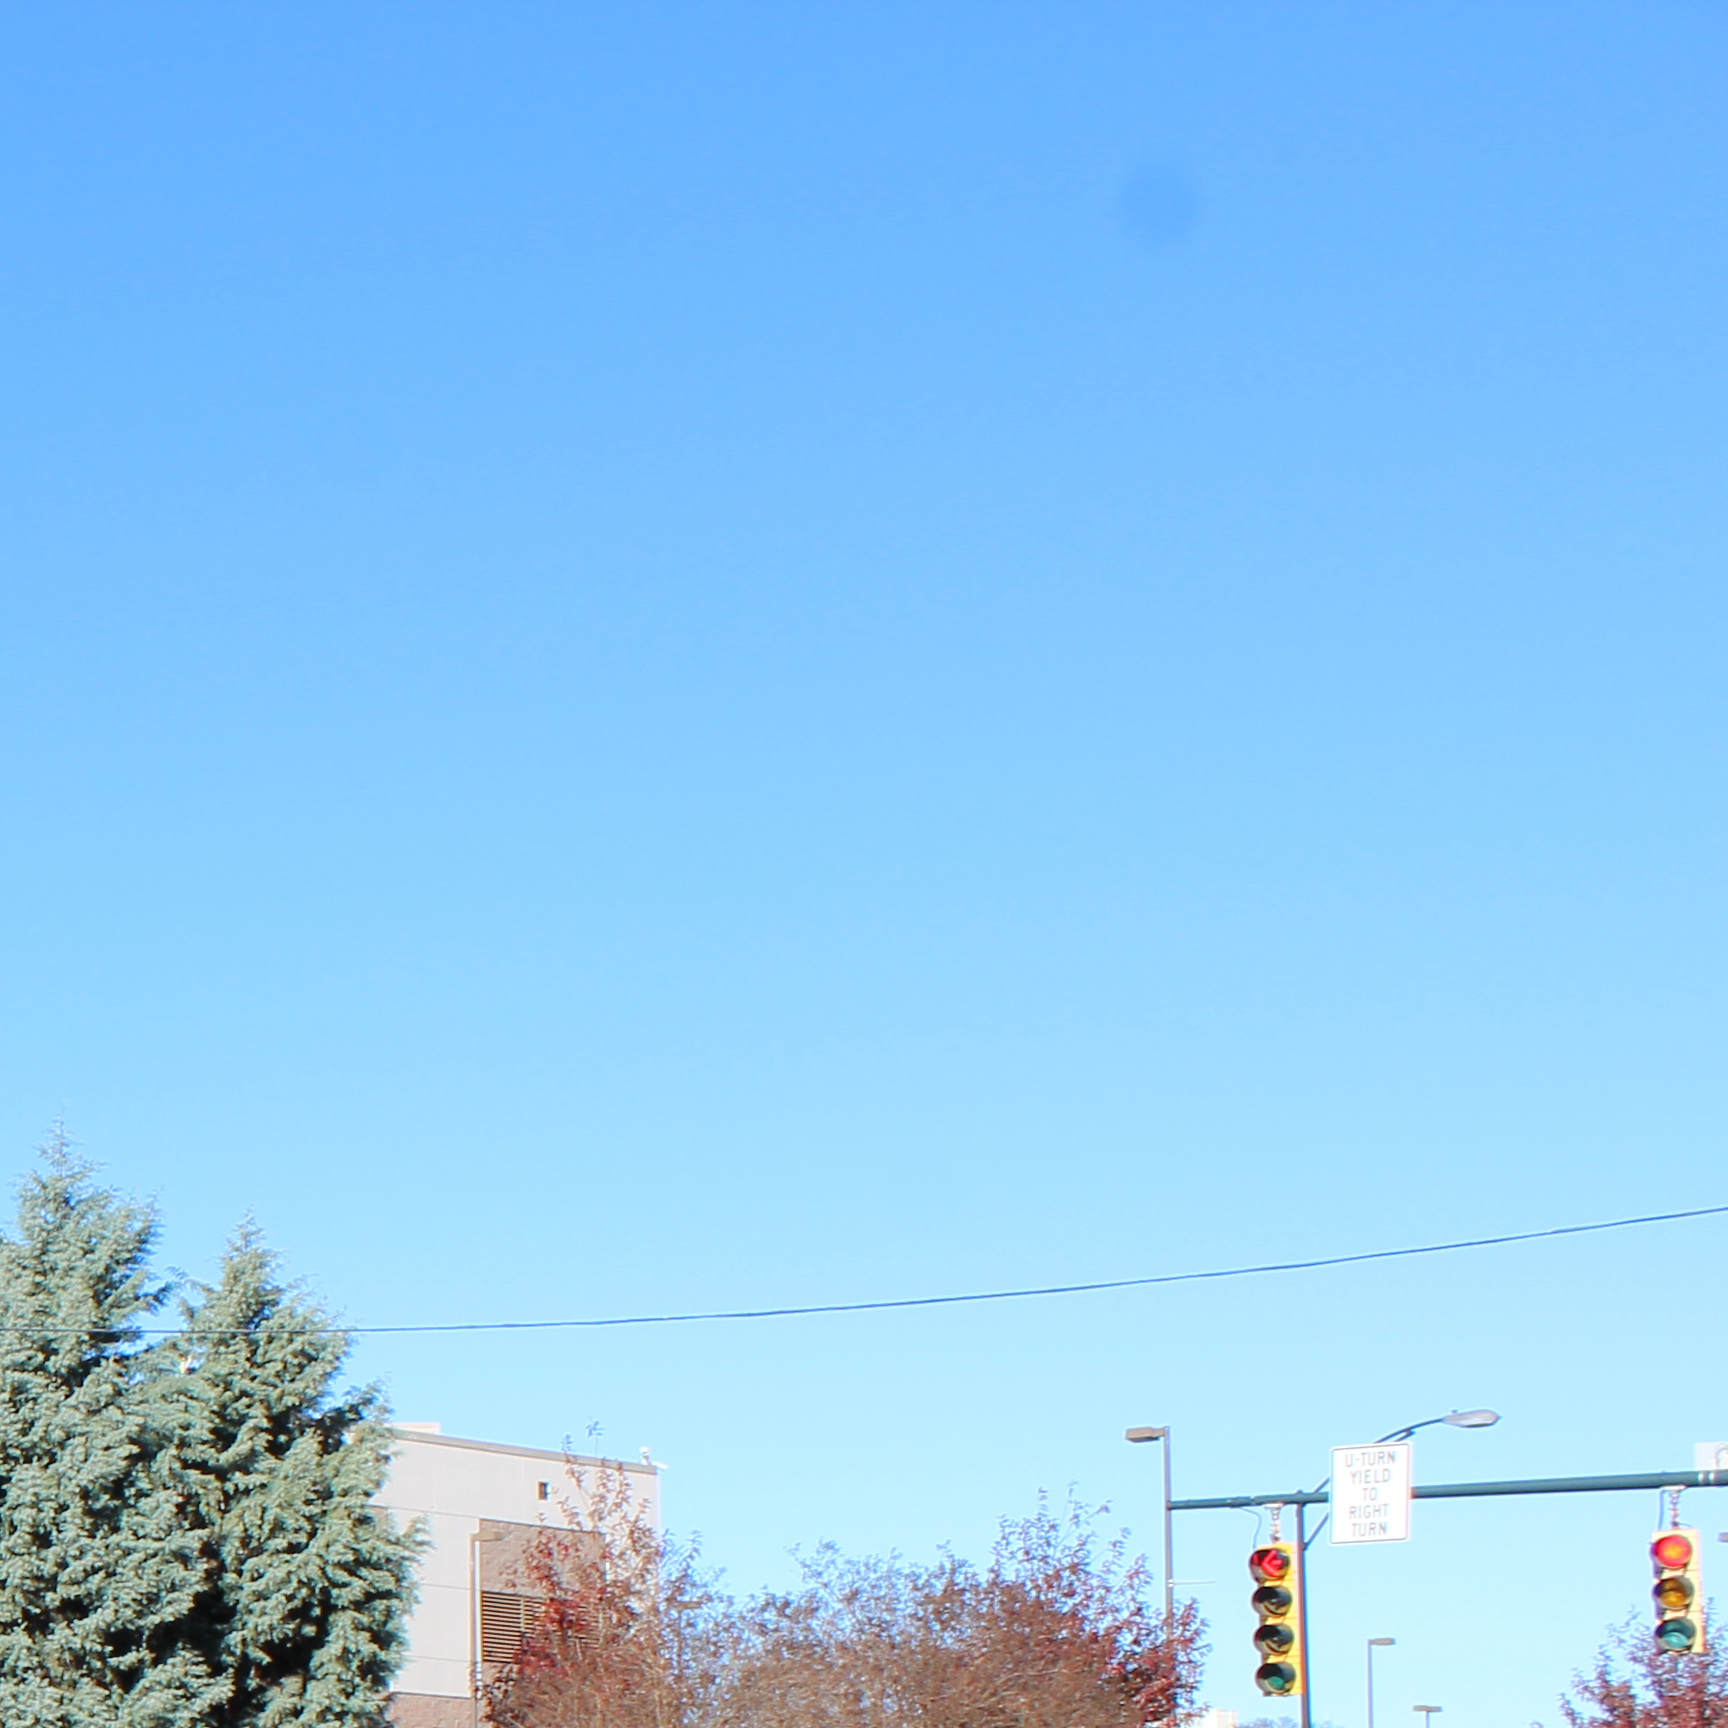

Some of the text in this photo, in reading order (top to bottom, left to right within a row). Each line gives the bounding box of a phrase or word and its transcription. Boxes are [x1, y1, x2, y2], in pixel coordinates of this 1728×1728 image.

[1344, 1450, 1396, 1468] U-TURN
[1349, 1468, 1392, 1485] YIELD
[1362, 1487, 1378, 1501] TO
[1348, 1503, 1389, 1520] RIGHT
[1350, 1521, 1387, 1538] TURN
